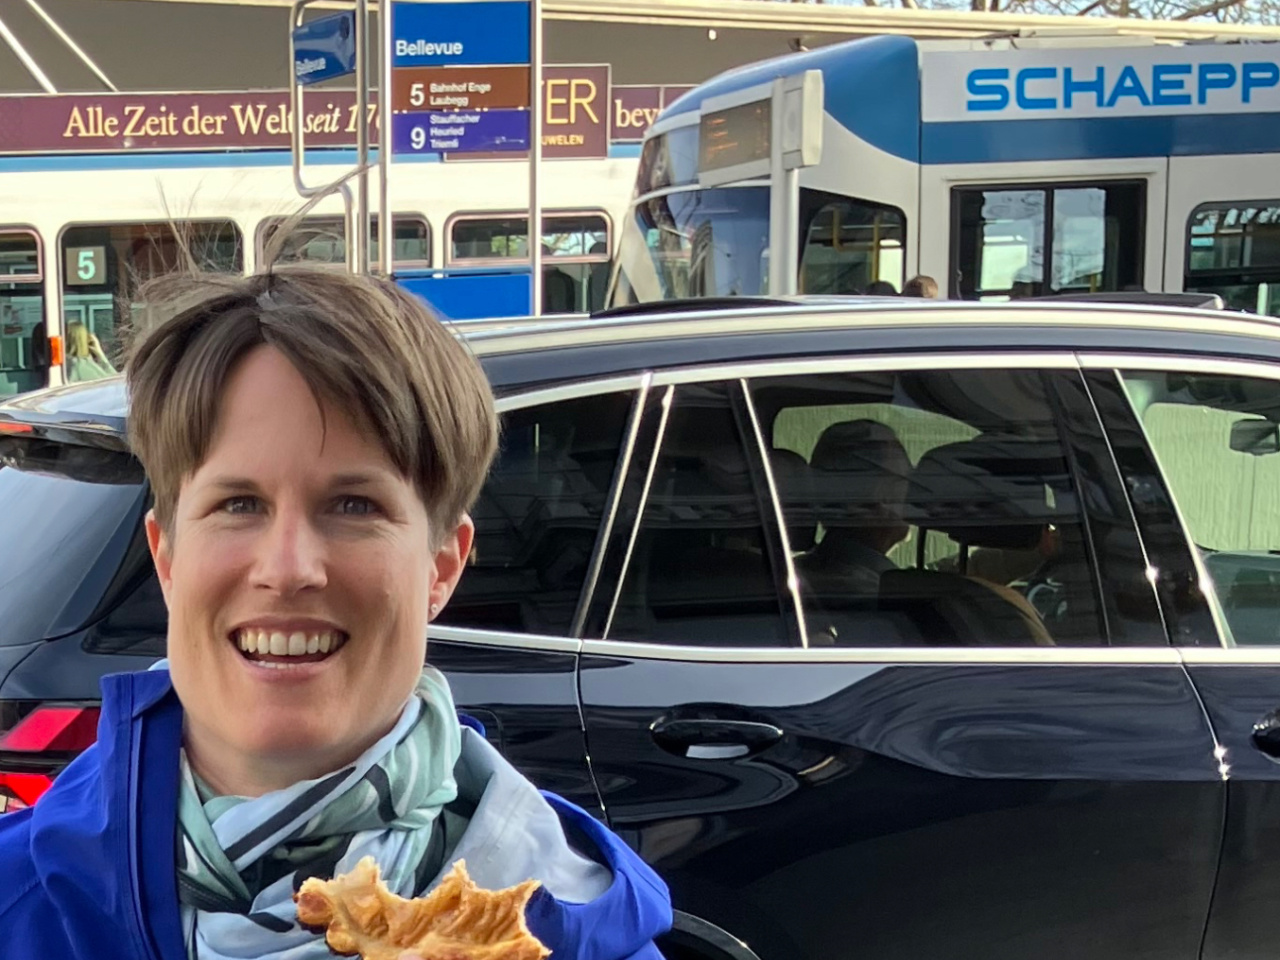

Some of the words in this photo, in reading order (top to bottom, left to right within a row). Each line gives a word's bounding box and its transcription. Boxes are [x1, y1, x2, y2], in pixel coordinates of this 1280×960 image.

[395, 39, 464, 57] Bellevue
[409, 83, 425, 107] 5
[430, 82, 467, 93] Bahnhof
[468, 82, 491, 94] Enge
[966, 61, 1280, 111] SCHAEPP
[430, 95, 469, 107] Laubegg
[542, 78, 599, 124] ER
[62, 105, 119, 138] Alle
[123, 103, 179, 137] Zeit
[182, 104, 227, 136] der
[303, 103, 342, 133] seit
[430, 114, 480, 125] Stauffacher
[410, 127, 426, 150] 9
[542, 134, 584, 146] UWELEN
[77, 250, 95, 280] 5
